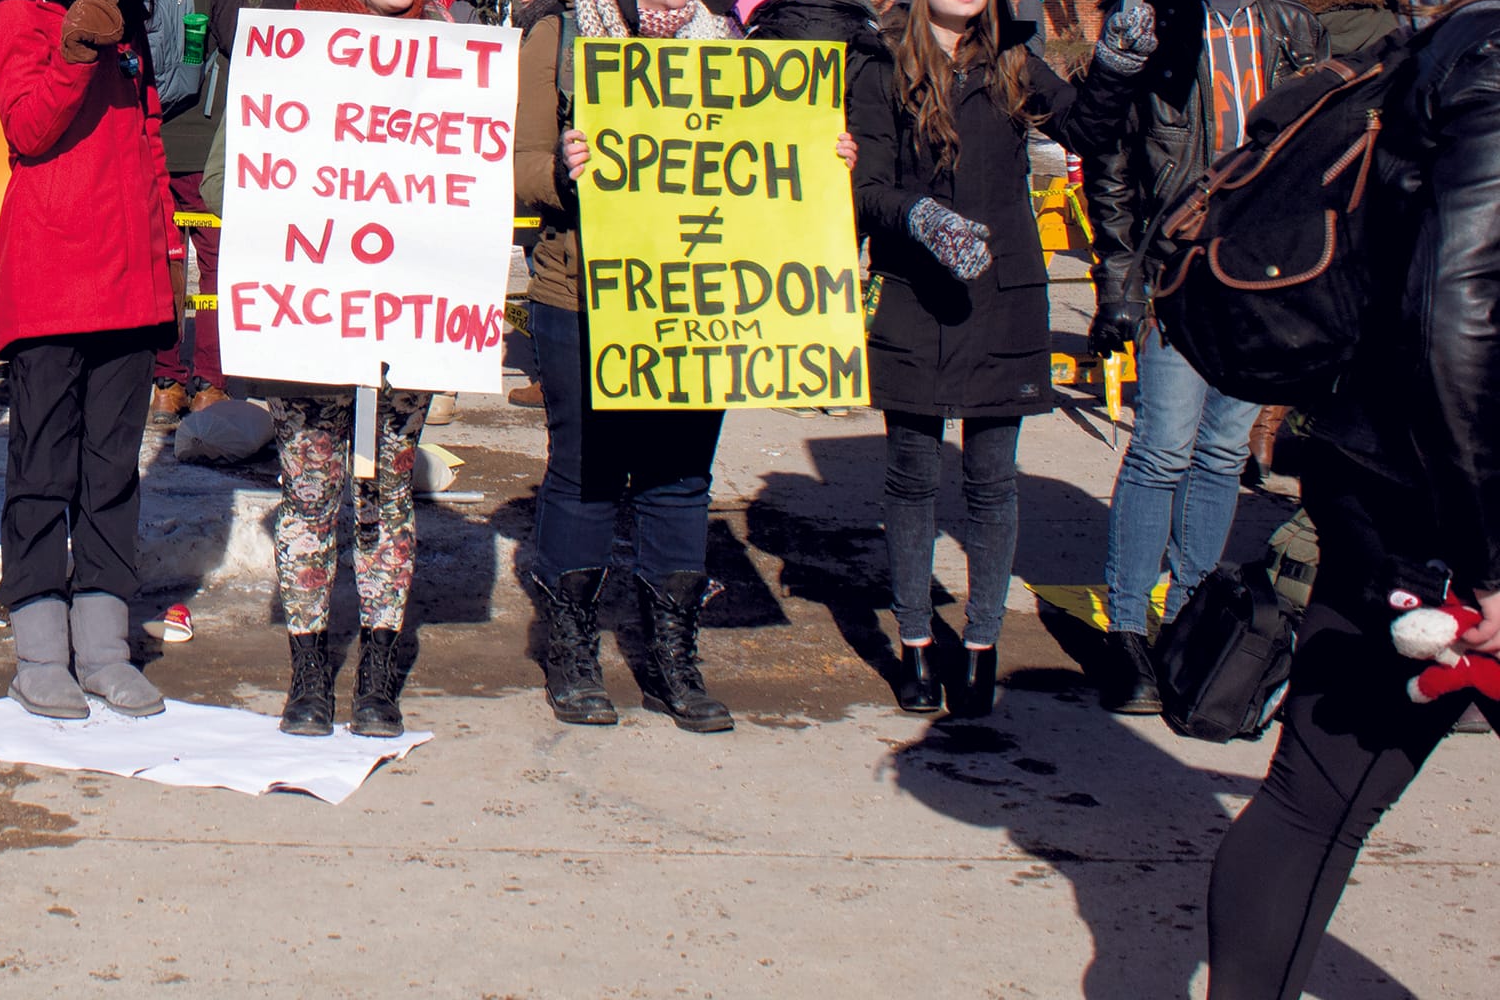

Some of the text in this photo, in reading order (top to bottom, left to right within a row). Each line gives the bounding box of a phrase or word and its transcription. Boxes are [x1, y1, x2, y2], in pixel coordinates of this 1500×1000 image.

[245, 24, 503, 89] NO GUILT
[583, 41, 843, 110] FREEDOM
[240, 92, 510, 163] NO REGRETS
[685, 112, 724, 132] OF
[237, 152, 477, 208] NO SHAME
[592, 128, 802, 202] SPEECH
[284, 218, 395, 265] NO
[231, 280, 504, 353] EXCEPTIONS
[588, 257, 856, 316] FREEDOM
[655, 317, 763, 343] FROM
[596, 342, 863, 404] CRITICISM
